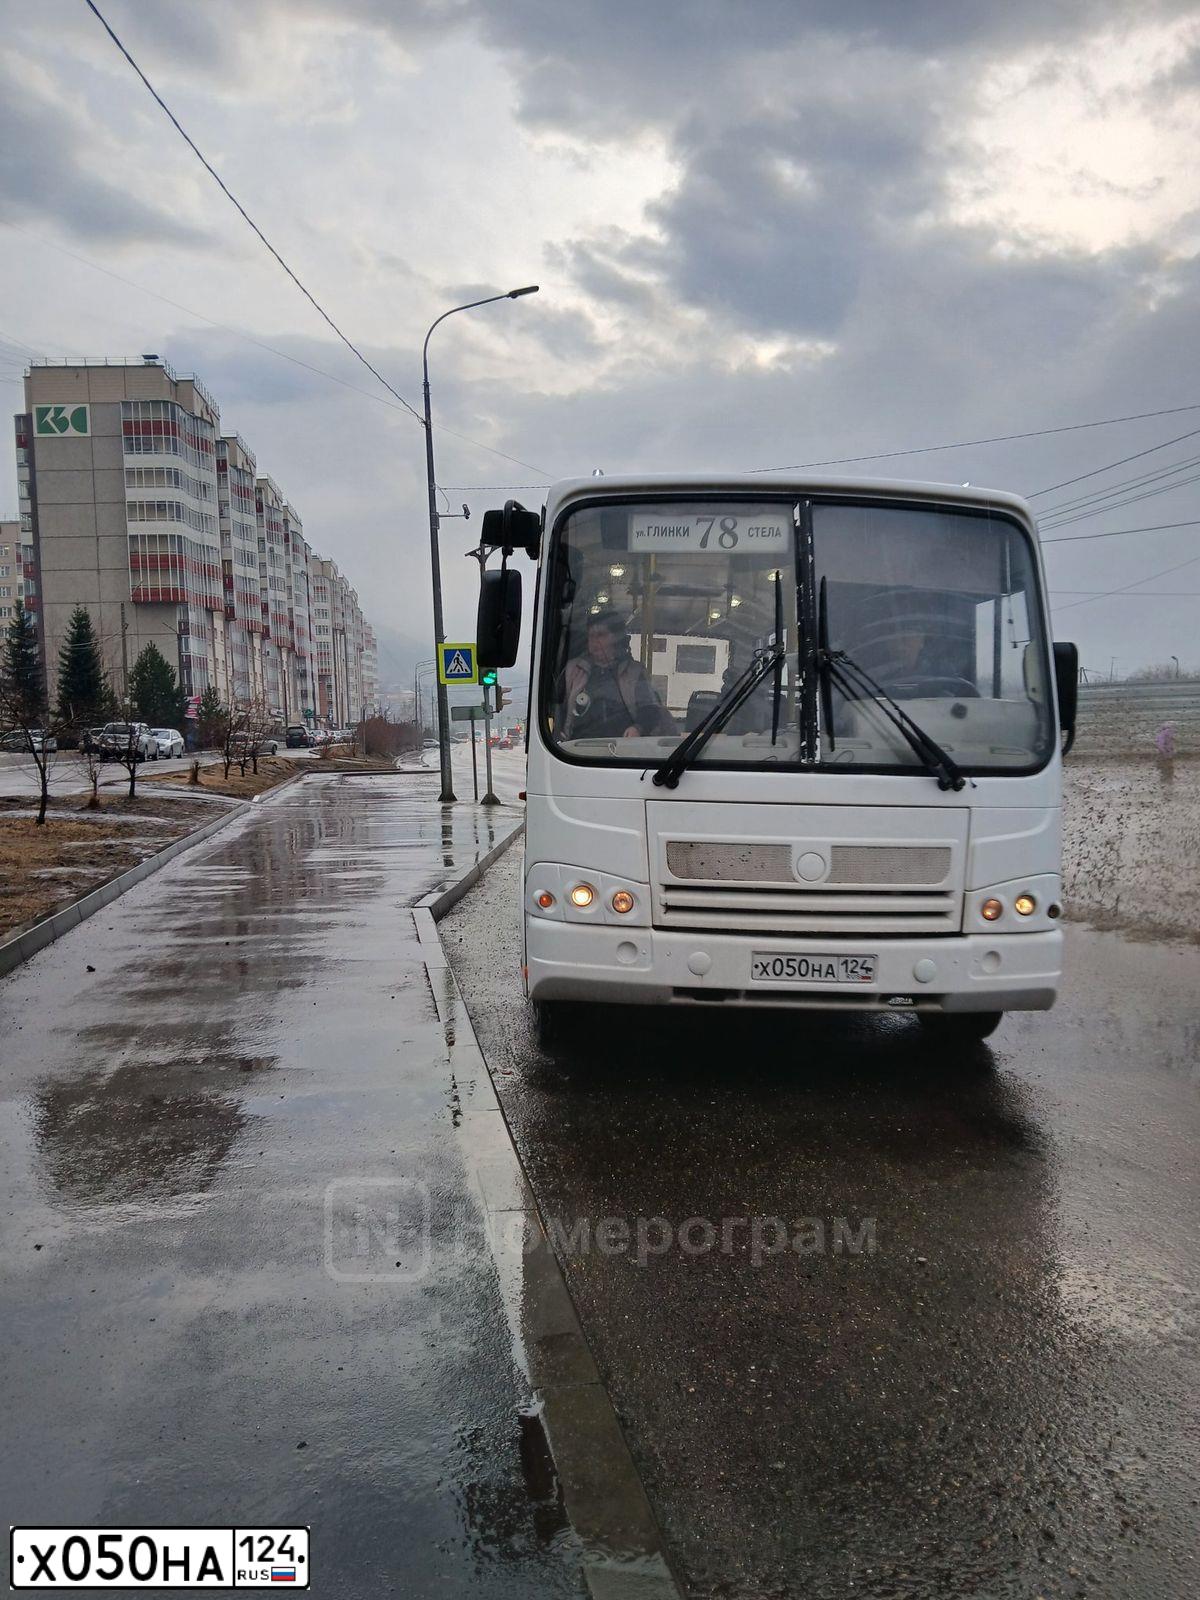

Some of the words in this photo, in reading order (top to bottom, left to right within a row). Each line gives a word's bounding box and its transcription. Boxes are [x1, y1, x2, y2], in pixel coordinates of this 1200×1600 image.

[695, 516, 739, 549] 78
[747, 526, 782, 538] СТЕЛА
[759, 957, 836, 978] Х050НА
